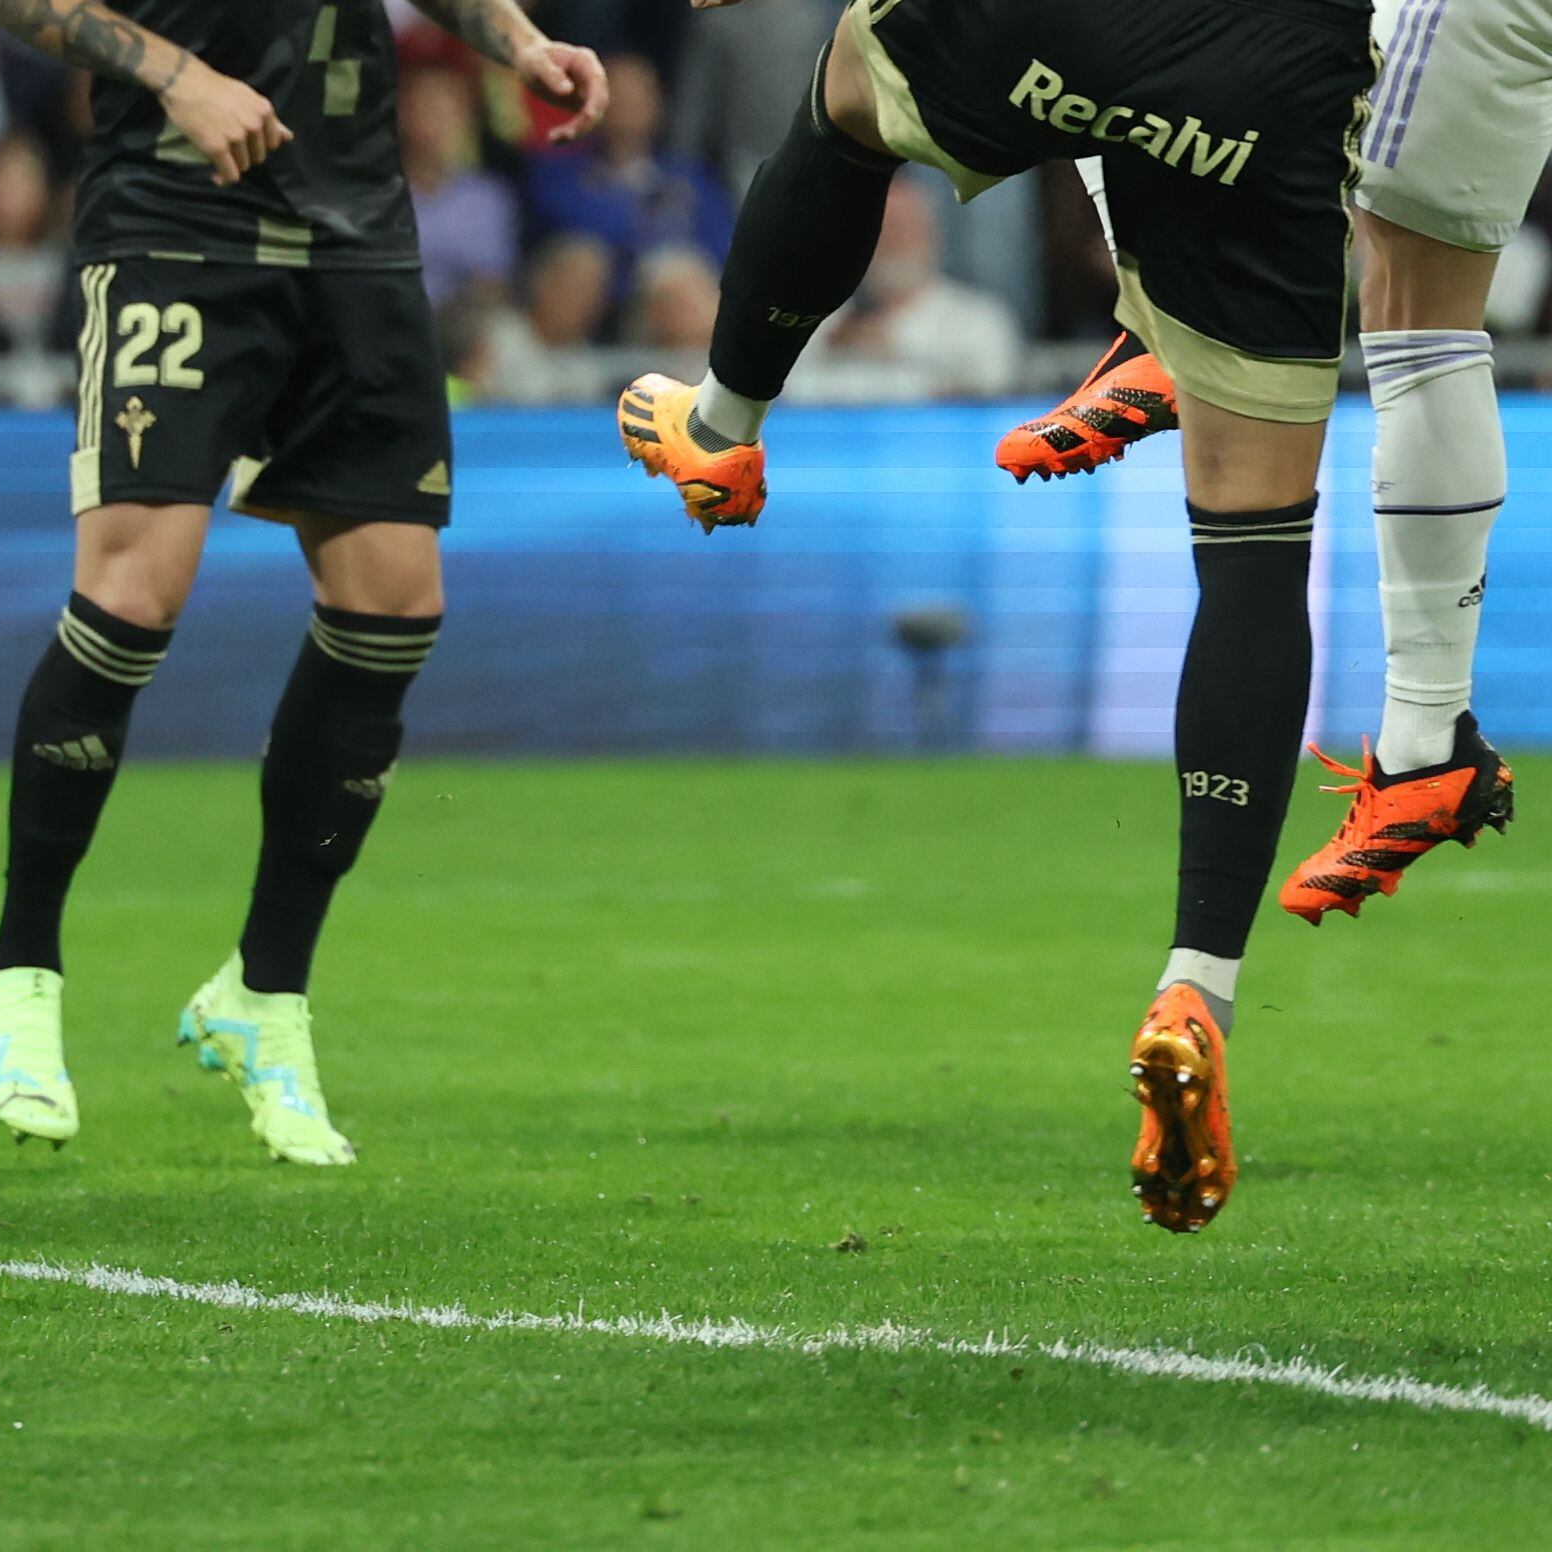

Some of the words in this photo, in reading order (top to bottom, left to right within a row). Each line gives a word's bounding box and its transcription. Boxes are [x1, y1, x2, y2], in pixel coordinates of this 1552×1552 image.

[1008, 58, 1260, 186] Recalvi
[113, 303, 205, 389] 22
[1183, 770, 1250, 807] 1923
